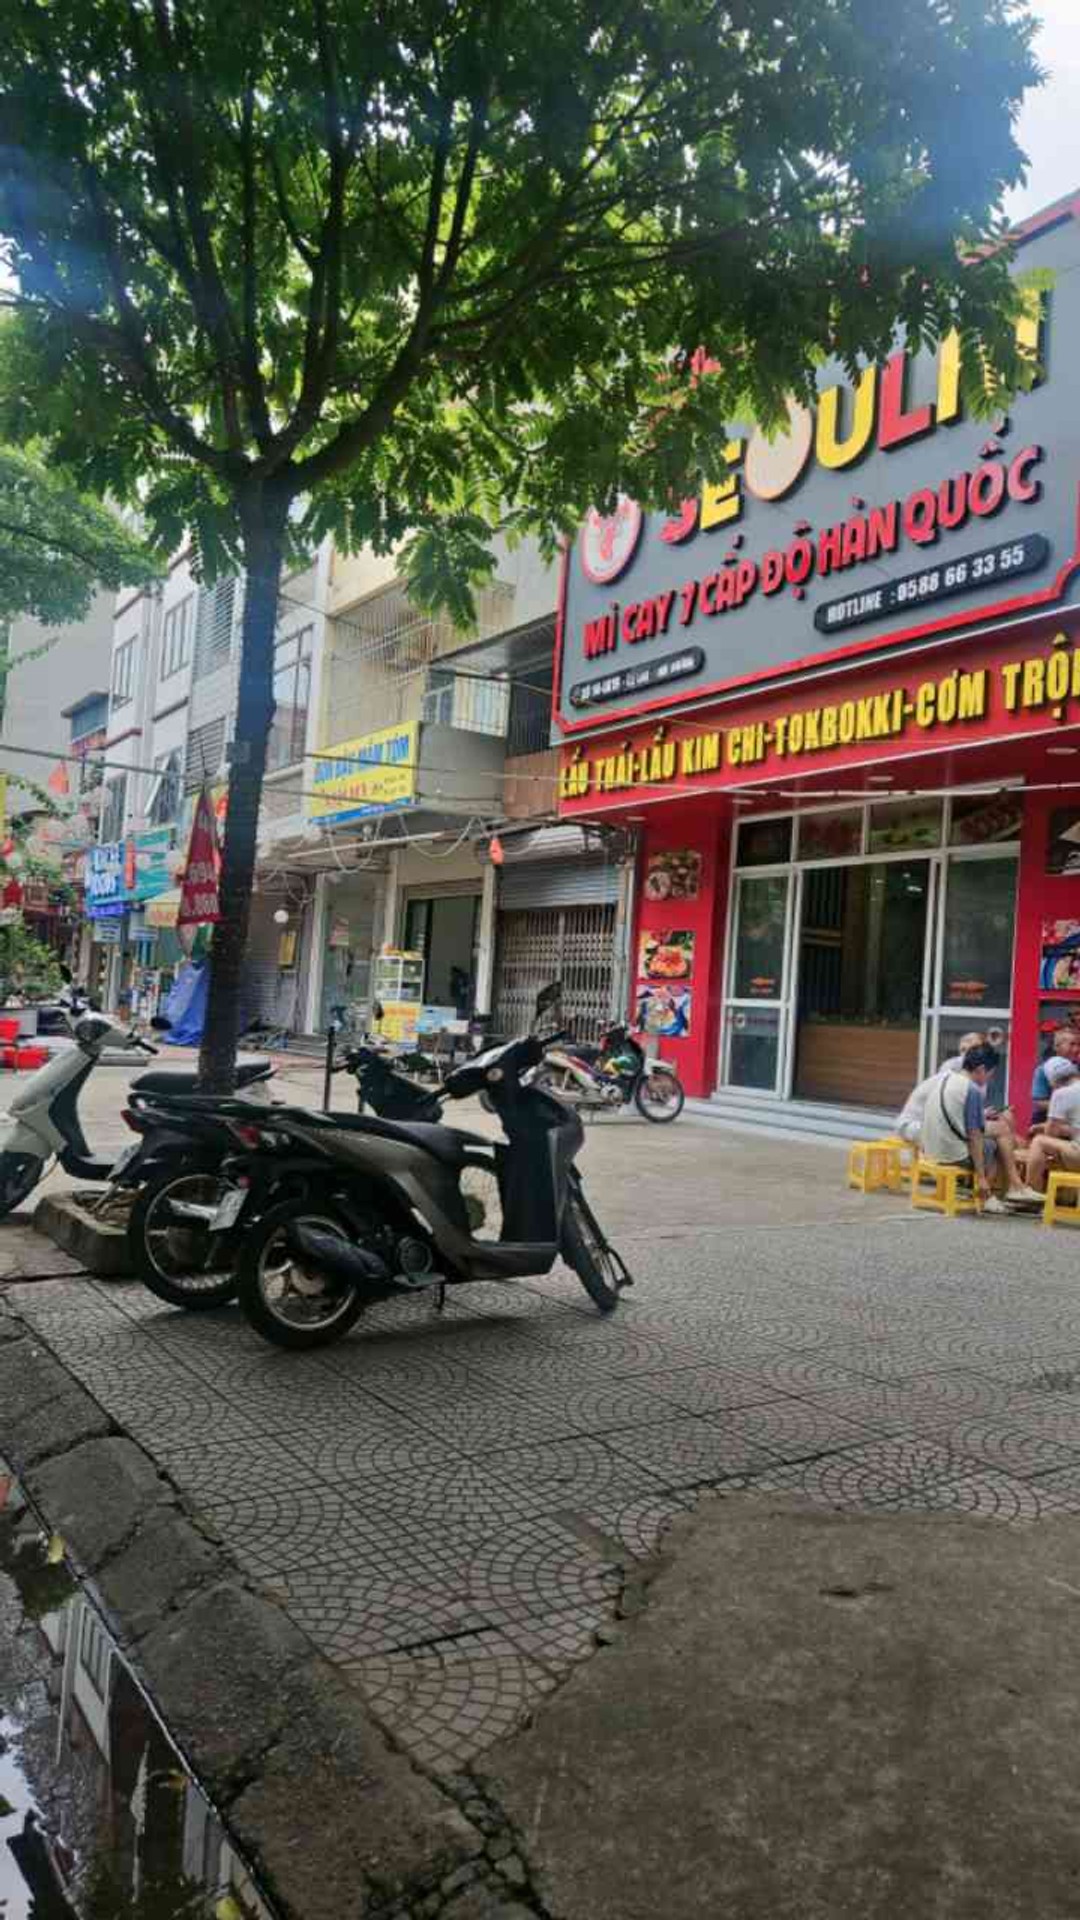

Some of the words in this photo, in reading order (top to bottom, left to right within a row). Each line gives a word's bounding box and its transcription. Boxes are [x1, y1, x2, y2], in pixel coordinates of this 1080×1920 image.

[622, 591, 674, 643] CAY
[680, 581, 698, 626] 7
[701, 534, 757, 615] CẤP
[762, 519, 813, 601] ĐỘ
[817, 495, 897, 576] HÀN
[904, 417, 1042, 545] QUỐC
[827, 590, 882, 624] HOTLINE
[944, 562, 967, 587] 66
[972, 553, 996, 579] 33
[1000, 544, 1025, 569] 55
[682, 731, 720, 775] KIM
